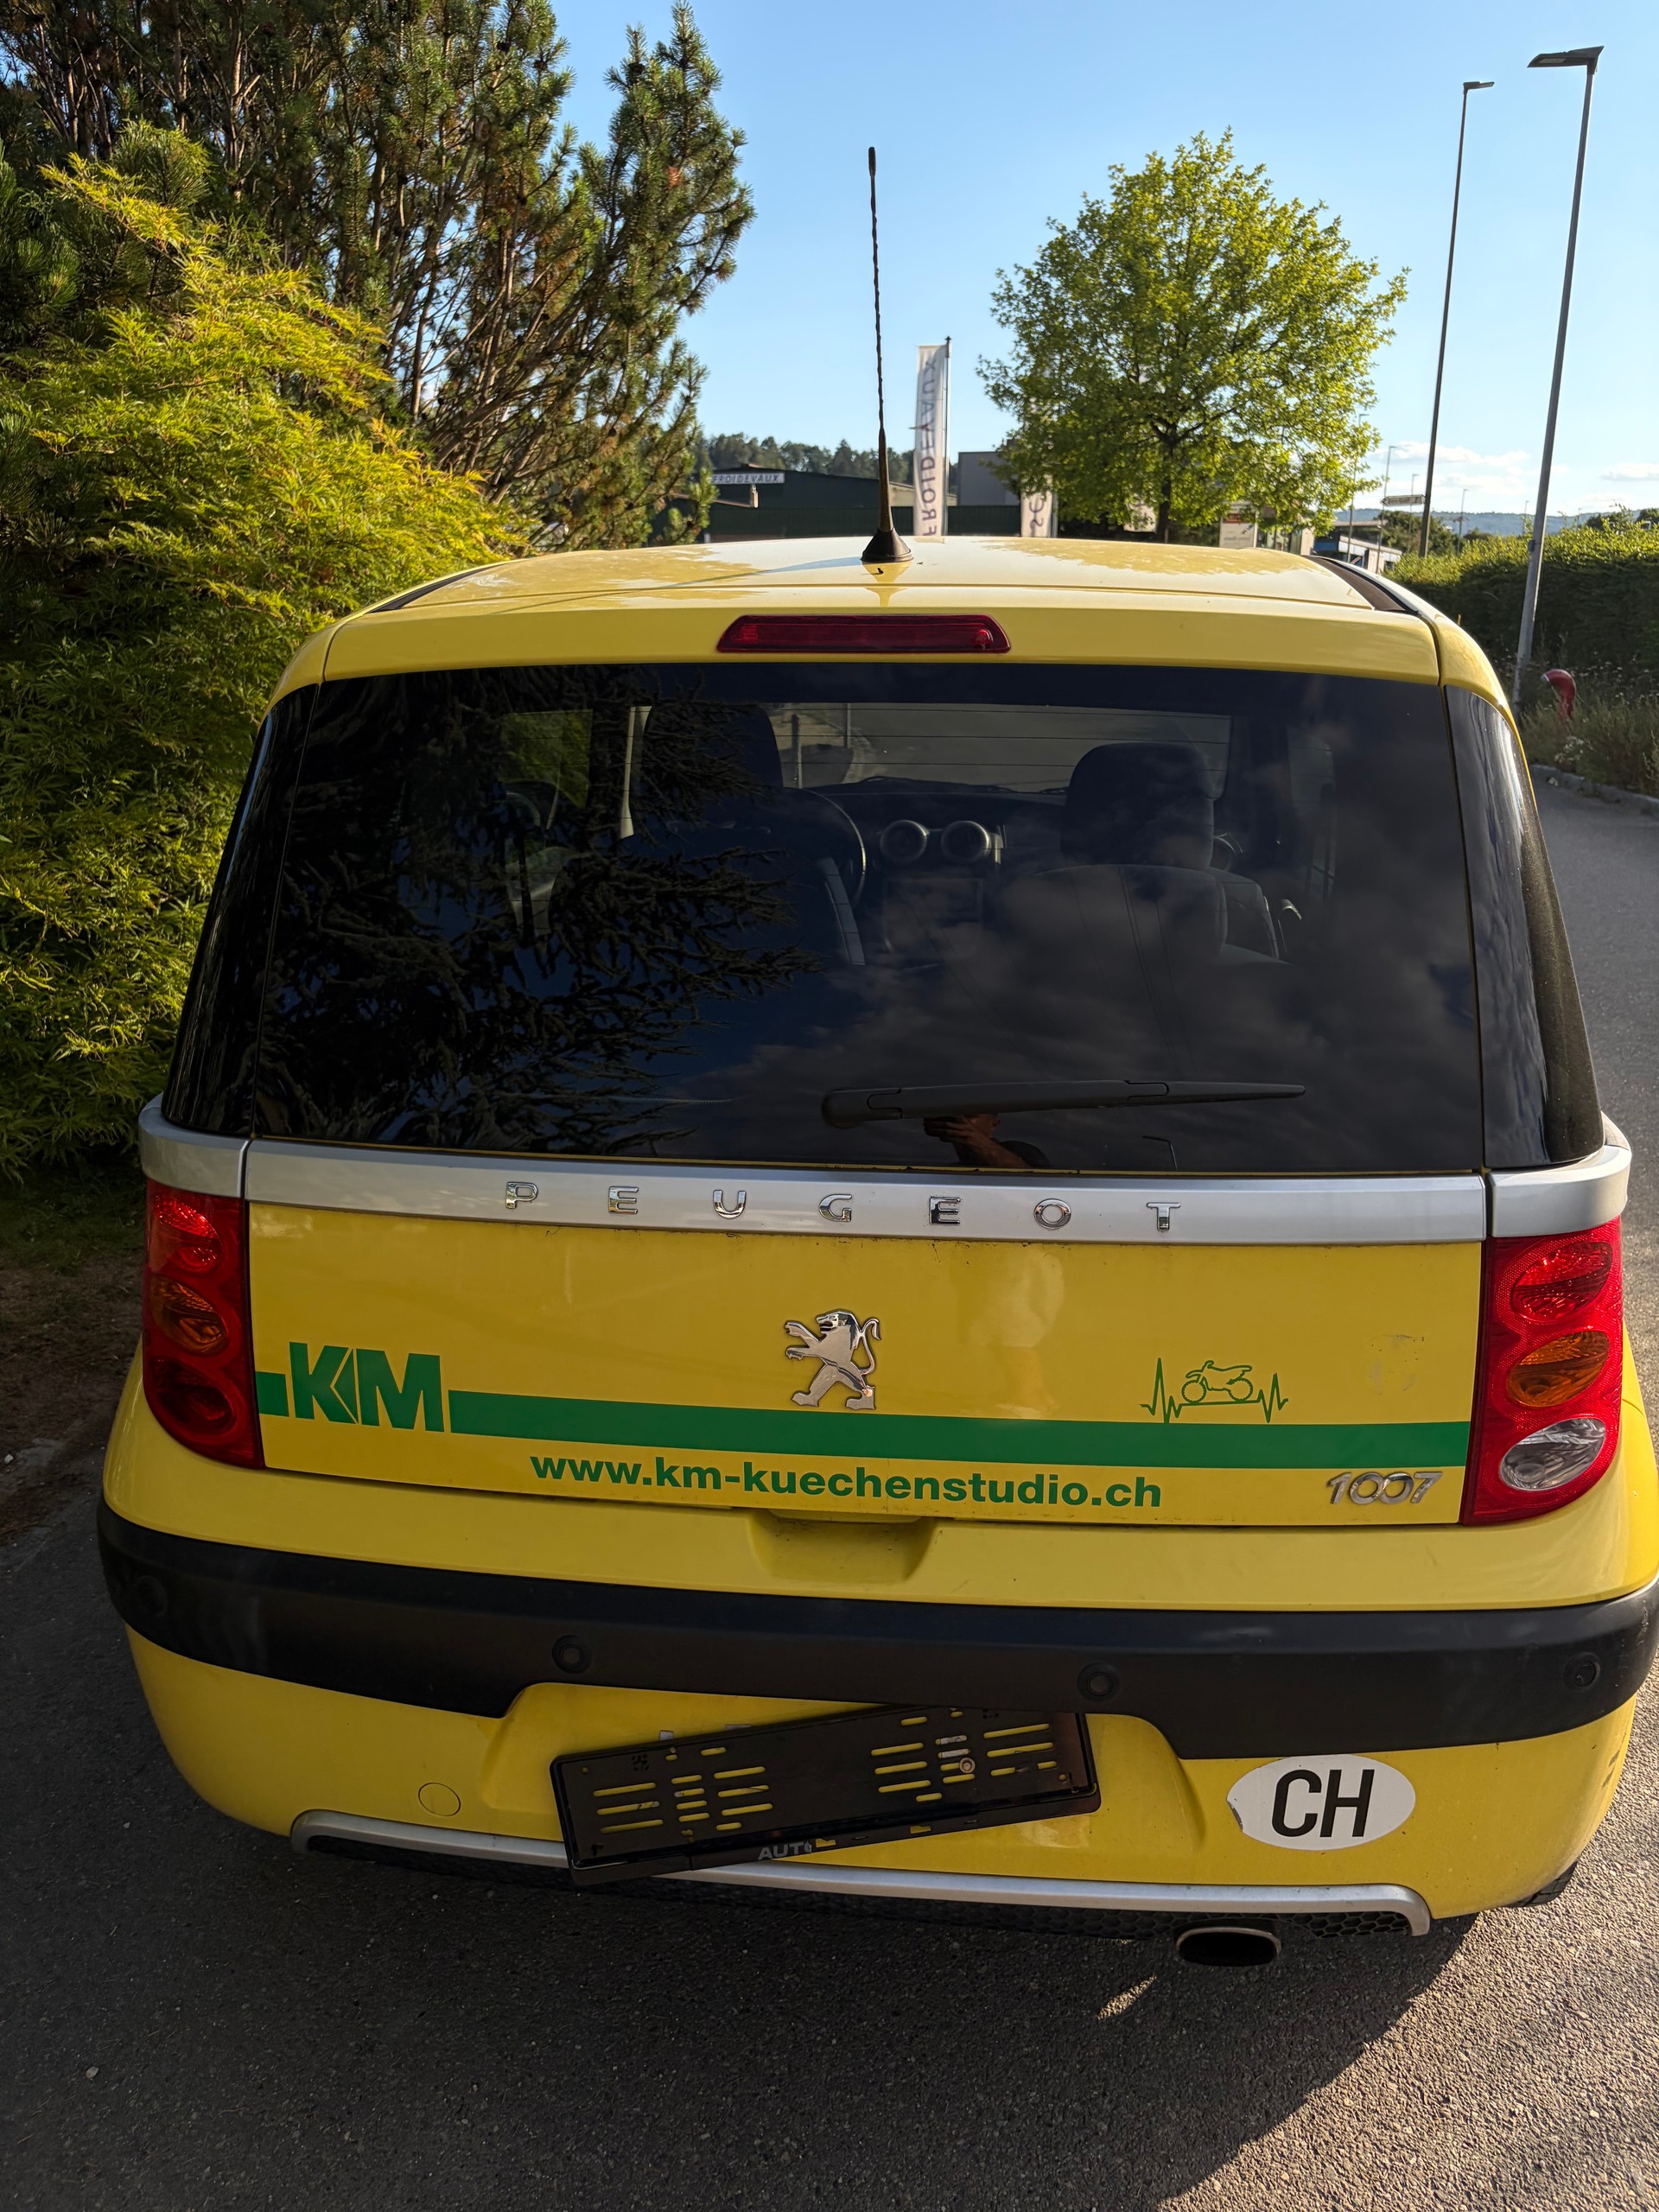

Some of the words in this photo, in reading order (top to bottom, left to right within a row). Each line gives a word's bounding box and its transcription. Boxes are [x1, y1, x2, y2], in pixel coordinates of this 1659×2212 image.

[505, 1180, 1182, 1233] PEUGEOT
[289, 1341, 444, 1433] KM
[530, 1455, 1161, 1508] www.km-kuechenstudio.ch
[1326, 1471, 1442, 1504] 1007
[1271, 1769, 1375, 1838] CH
